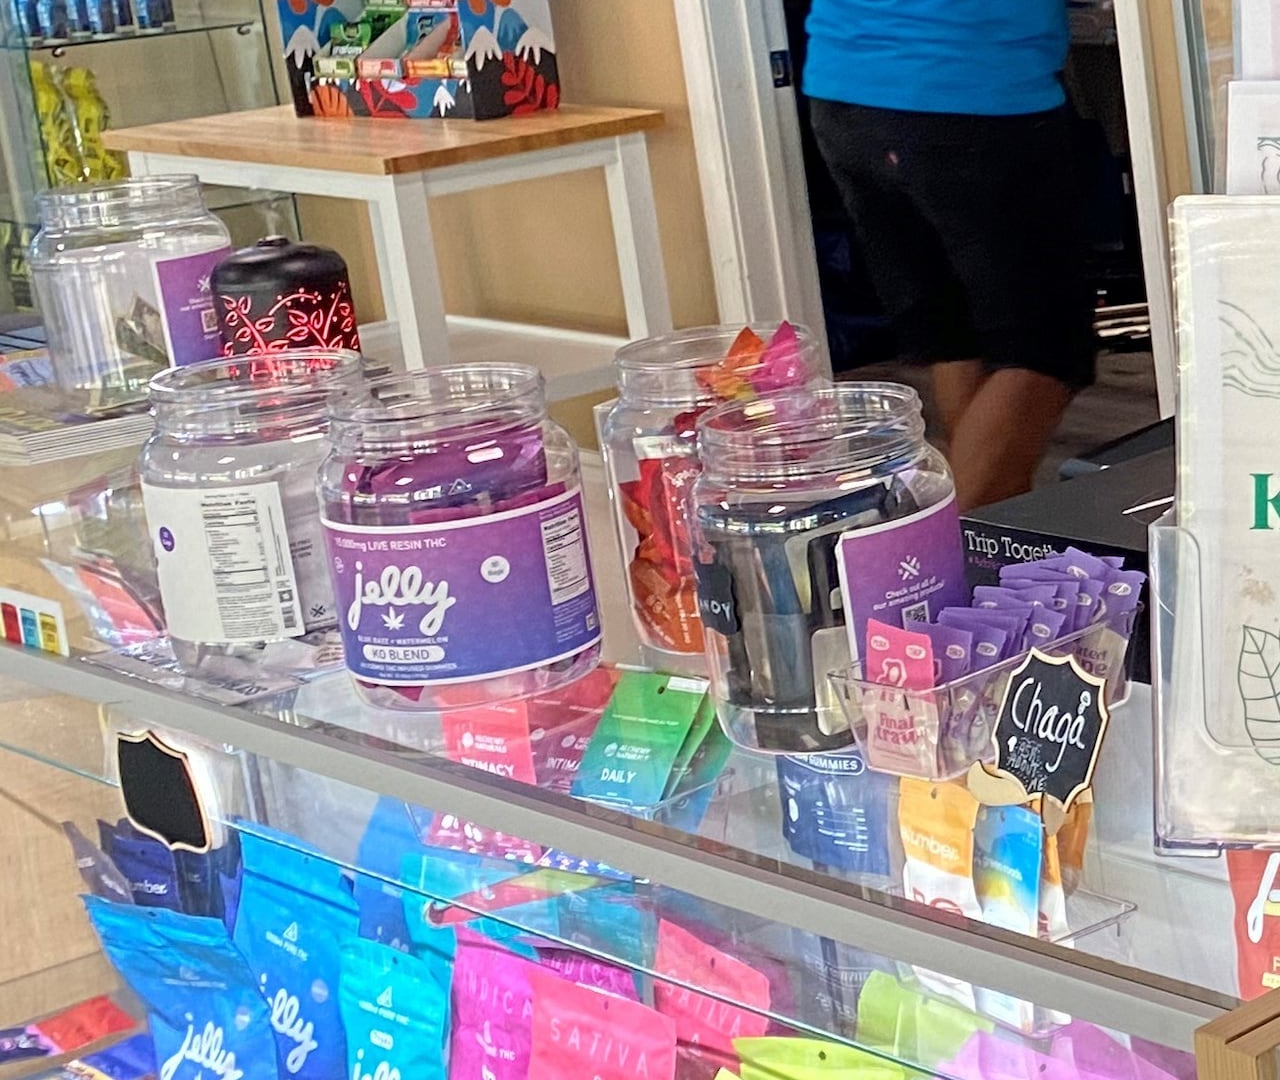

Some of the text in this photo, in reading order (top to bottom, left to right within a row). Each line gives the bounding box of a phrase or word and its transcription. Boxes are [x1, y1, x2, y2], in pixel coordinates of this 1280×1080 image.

[368, 538, 447, 551] LIVE RESIN THC
[964, 530, 999, 557] Trip
[348, 561, 456, 636] jelly
[885, 589, 906, 600] Check
[908, 584, 920, 593] out
[396, 636, 448, 645] WATERMELON
[389, 649, 430, 660] BLEND
[879, 712, 915, 729] Final
[1012, 677, 1085, 772] Chaga
[619, 743, 652, 755] ALCHEMY
[809, 754, 859, 771] GUMMIES
[600, 768, 636, 784] DAILY
[1029, 776, 1046, 792] ME
[460, 971, 534, 1017] INDICA
[550, 1018, 648, 1077] SATIVA
